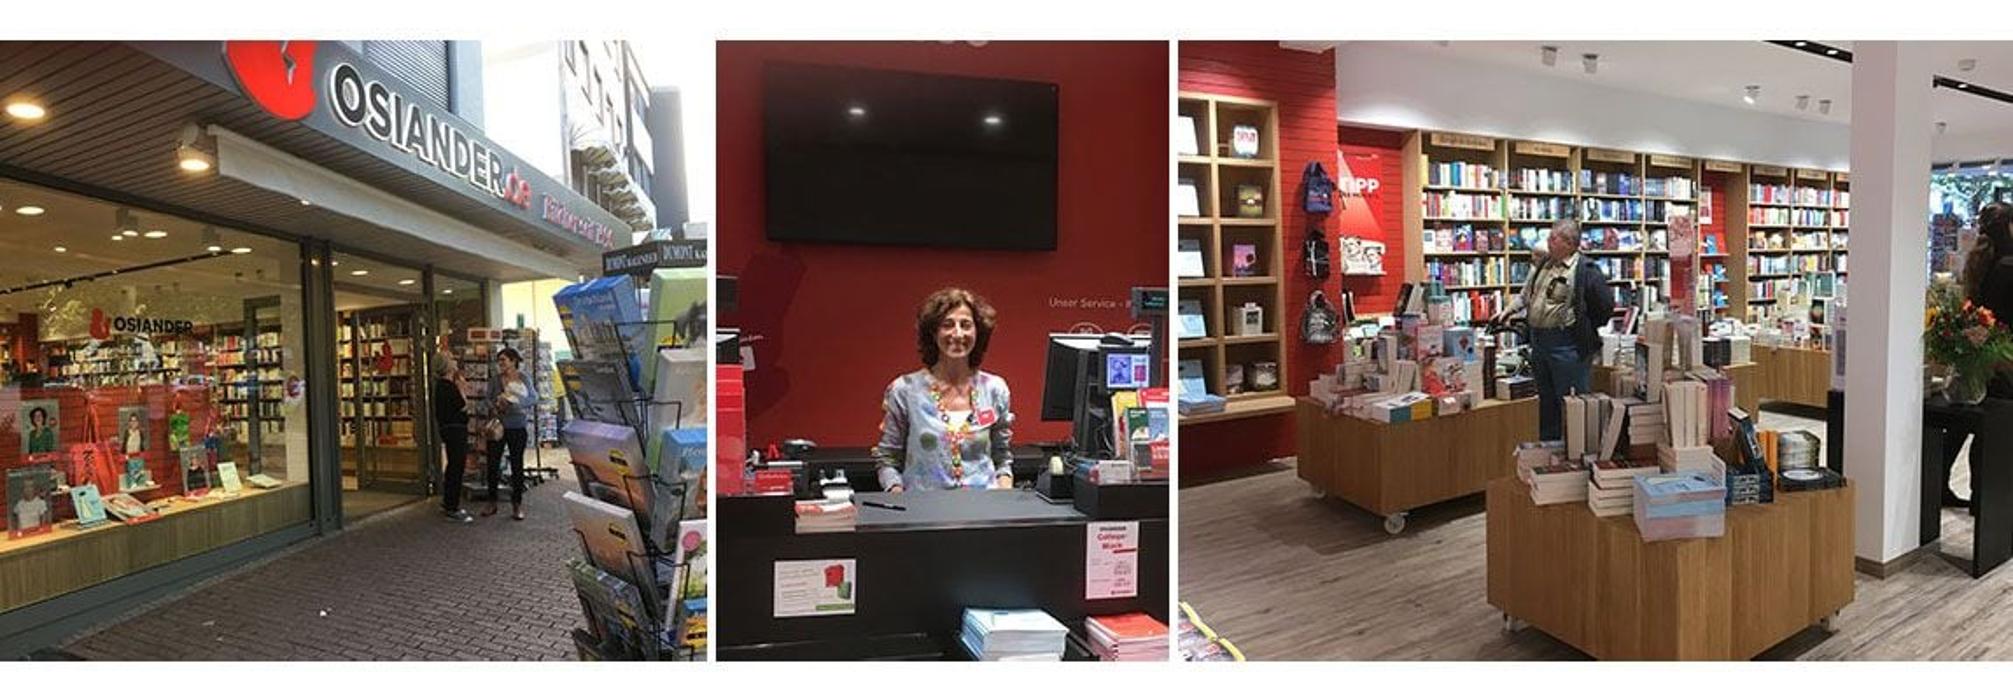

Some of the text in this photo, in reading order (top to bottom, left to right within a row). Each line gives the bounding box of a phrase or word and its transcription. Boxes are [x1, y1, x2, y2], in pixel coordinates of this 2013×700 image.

[1049, 297, 1077, 308] Unser
[1079, 298, 1116, 309] Service
[113, 316, 194, 334] OSIANDER
